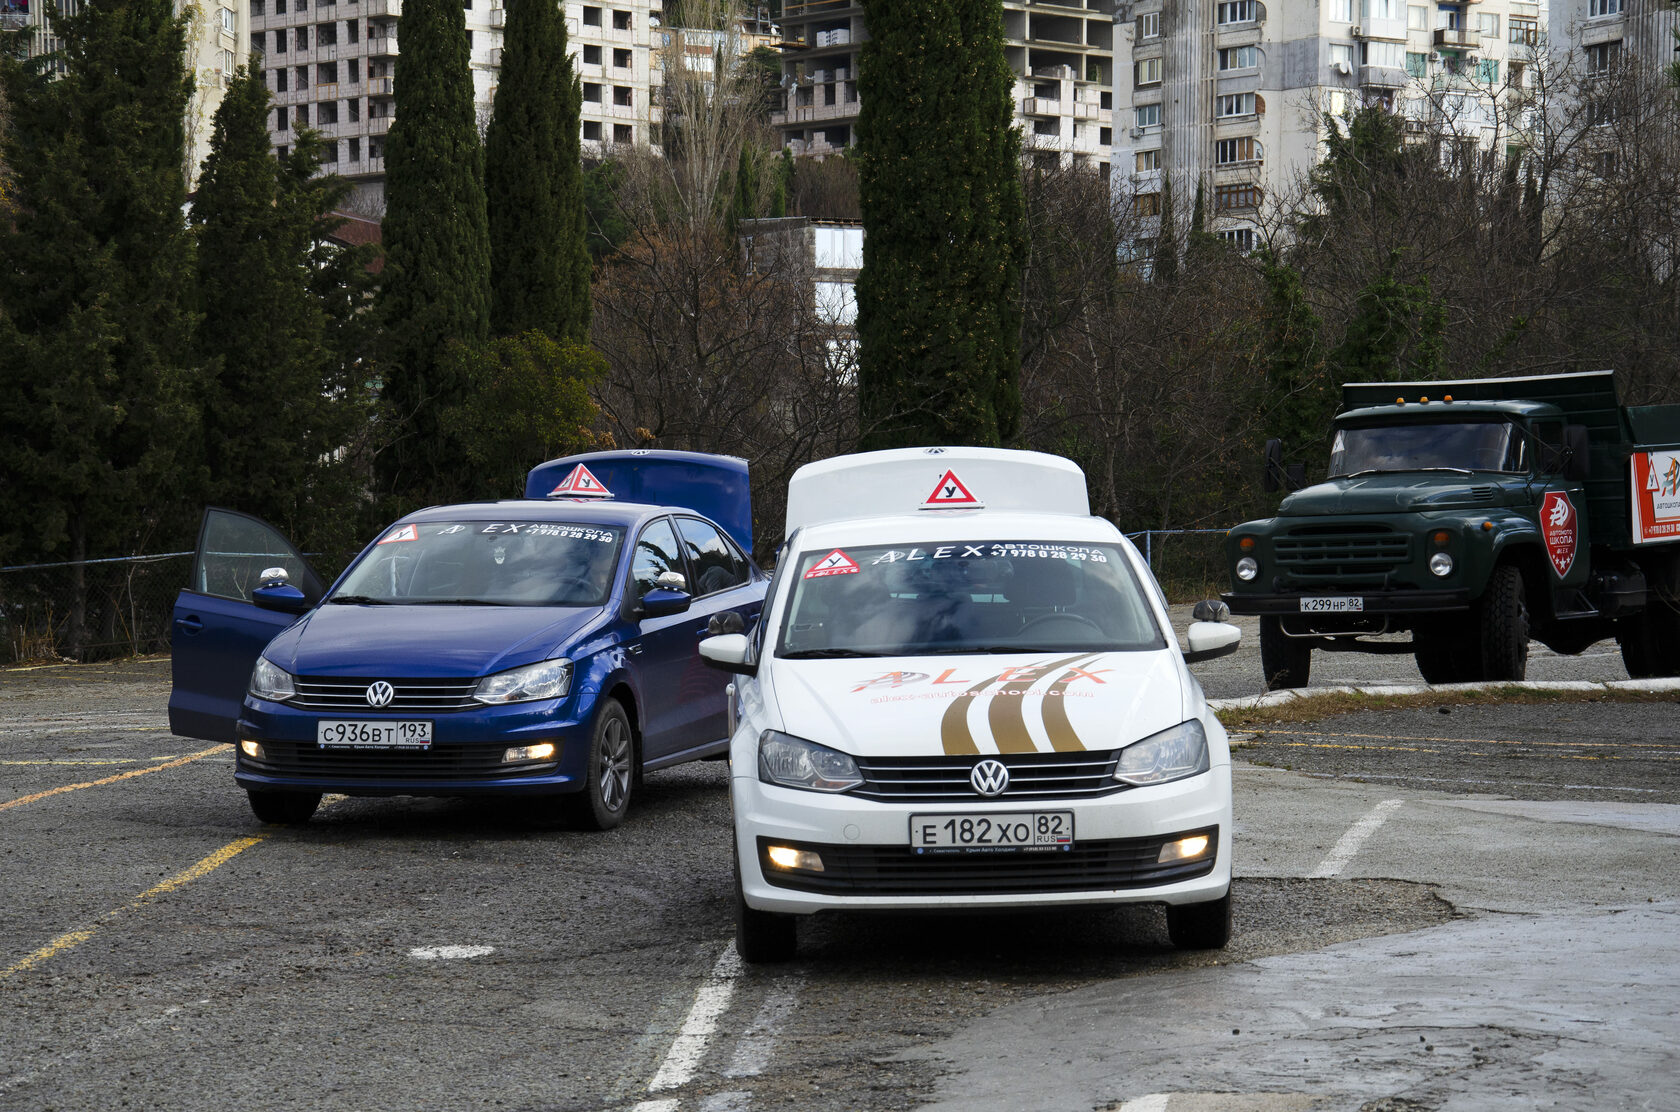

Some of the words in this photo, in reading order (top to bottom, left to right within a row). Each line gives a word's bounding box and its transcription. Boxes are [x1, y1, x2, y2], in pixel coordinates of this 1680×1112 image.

[944, 486, 957, 498] У
[529, 523, 613, 537] АВТОШКОЛА
[541, 528, 559, 536] 978
[1549, 535, 1573, 545] ШКОЛА
[872, 544, 985, 566] ALEX
[991, 543, 1104, 555] АВТОШКОЛА
[990, 549, 1007, 557] +7
[1010, 549, 1036, 558] 978
[1038, 550, 1048, 558] 0
[1050, 551, 1067, 559] 28
[1070, 552, 1087, 560] 29
[1090, 554, 1108, 563] 30
[1348, 598, 1360, 607] 82
[850, 666, 1117, 693] ALEX
[399, 723, 427, 738] 193
[1036, 815, 1064, 835] 82
[1036, 835, 1056, 843] RUS
